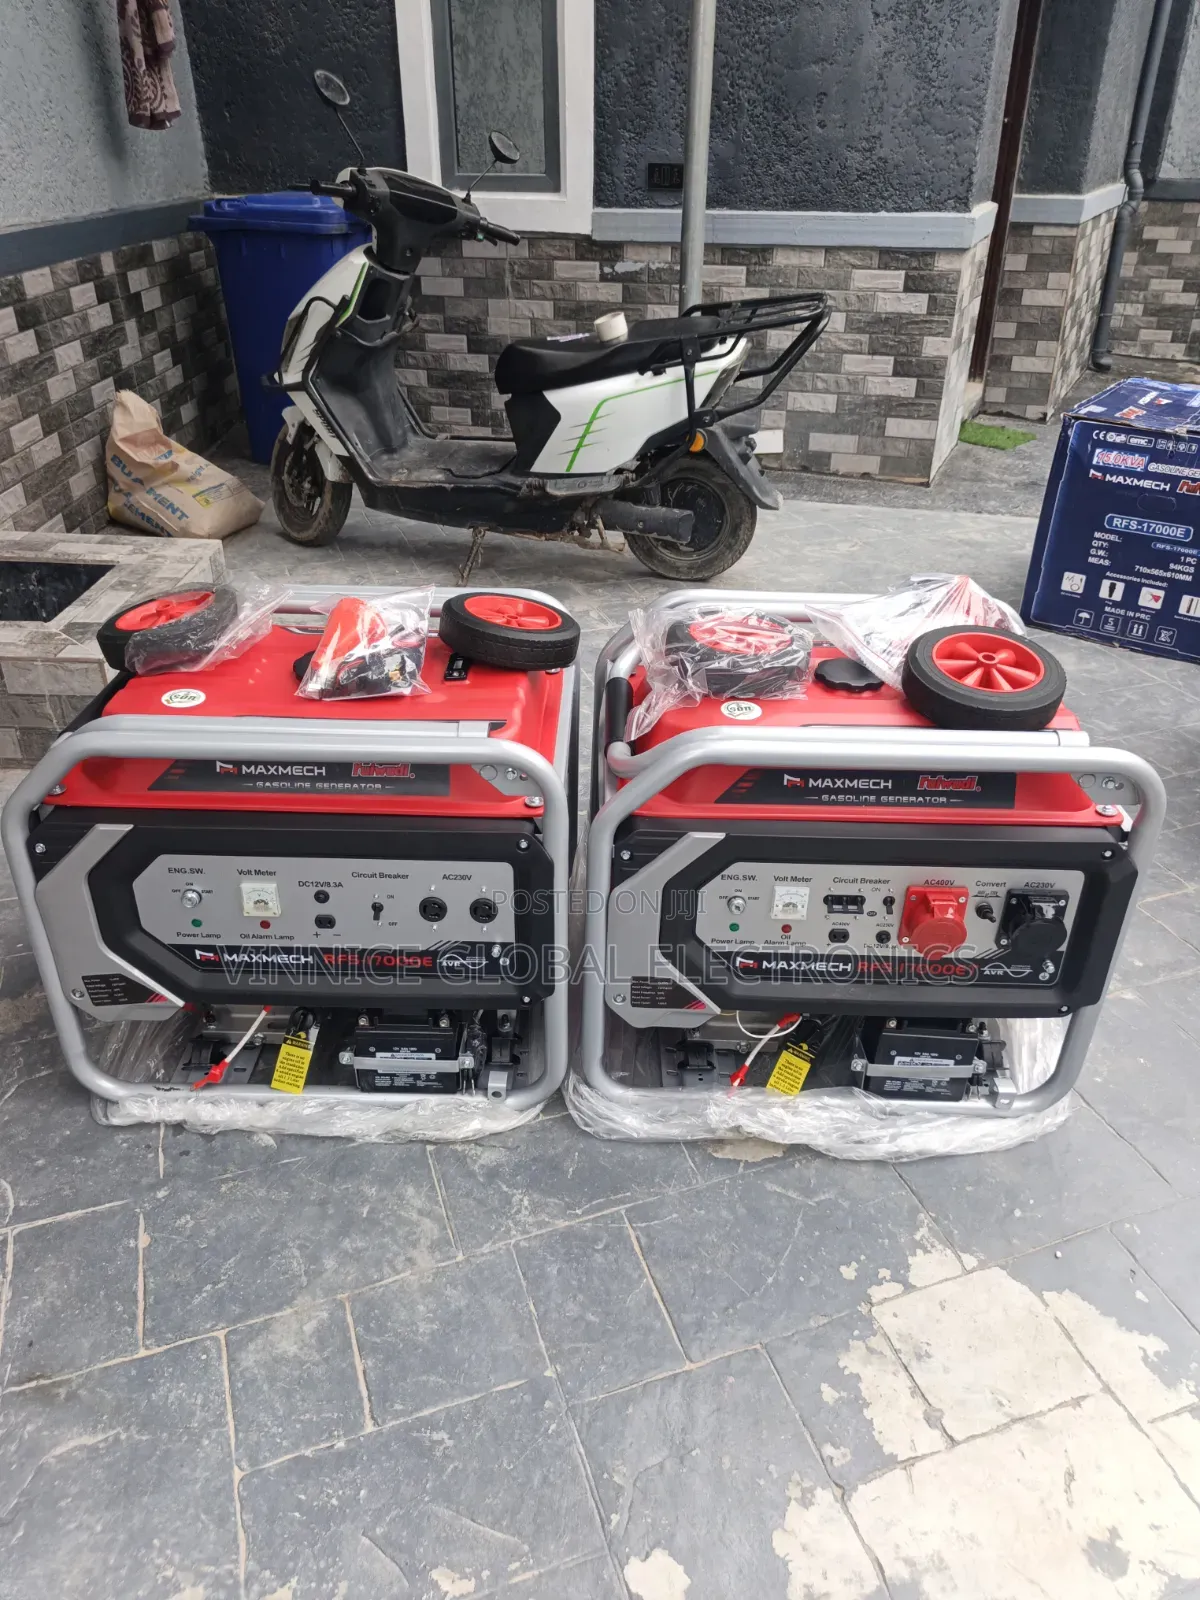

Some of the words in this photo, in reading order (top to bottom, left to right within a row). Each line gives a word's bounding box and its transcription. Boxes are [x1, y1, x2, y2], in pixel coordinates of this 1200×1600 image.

[1105, 474, 1171, 491] MAXMECH
[1112, 517, 1187, 538] RFS-17000E
[1094, 532, 1123, 542] MODEL:
[1092, 541, 1109, 549] QTY:
[1088, 556, 1111, 566] MEAS:
[1106, 571, 1141, 582] Accessories
[1104, 606, 1125, 616] MADE
[1135, 613, 1151, 621] PRC
[242, 765, 326, 776] MAXMECH
[256, 781, 311, 789] GASOLINE
[808, 778, 892, 789] MAXMECH
[821, 795, 877, 803] GASOLINE
[881, 796, 947, 804] GENERATOR
[168, 867, 206, 875] ENG.SW.
[351, 872, 378, 880] Circuit
[721, 874, 758, 882] ENG.SW.
[832, 877, 858, 885] Circuit
[298, 880, 344, 889] DC12V/8.3A
[975, 880, 1007, 888] Convert
[224, 953, 313, 964] MAXMECH
[762, 960, 851, 972] MAXMECH
